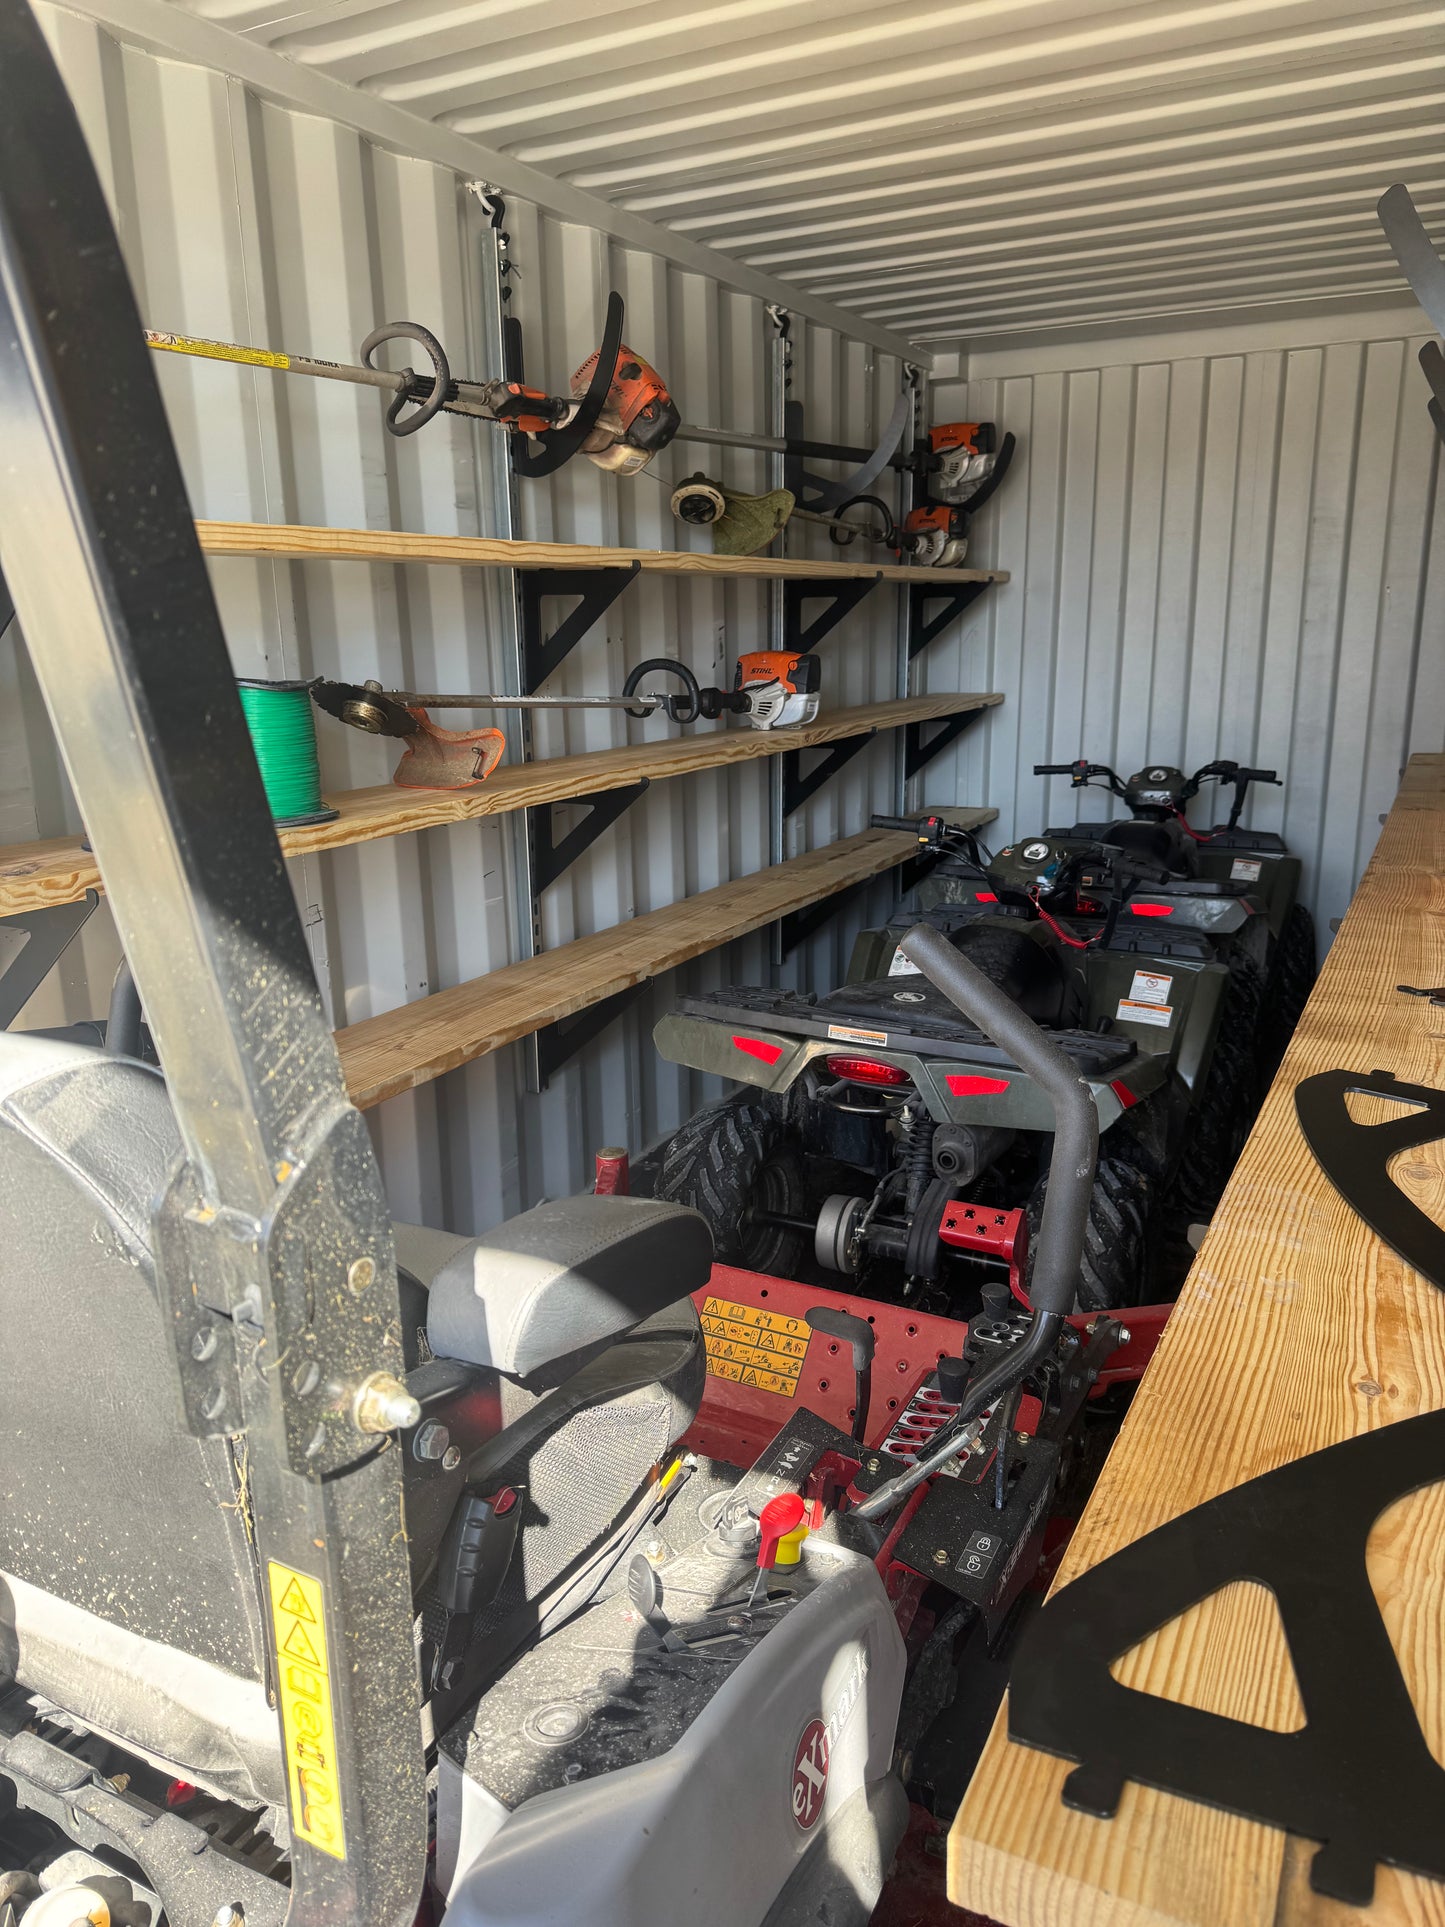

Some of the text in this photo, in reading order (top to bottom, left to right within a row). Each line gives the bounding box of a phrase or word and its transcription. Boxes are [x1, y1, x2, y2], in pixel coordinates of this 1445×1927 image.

[750, 667, 774, 675] STIHL
[776, 1468, 786, 1477] N
[771, 1476, 781, 1485] R
